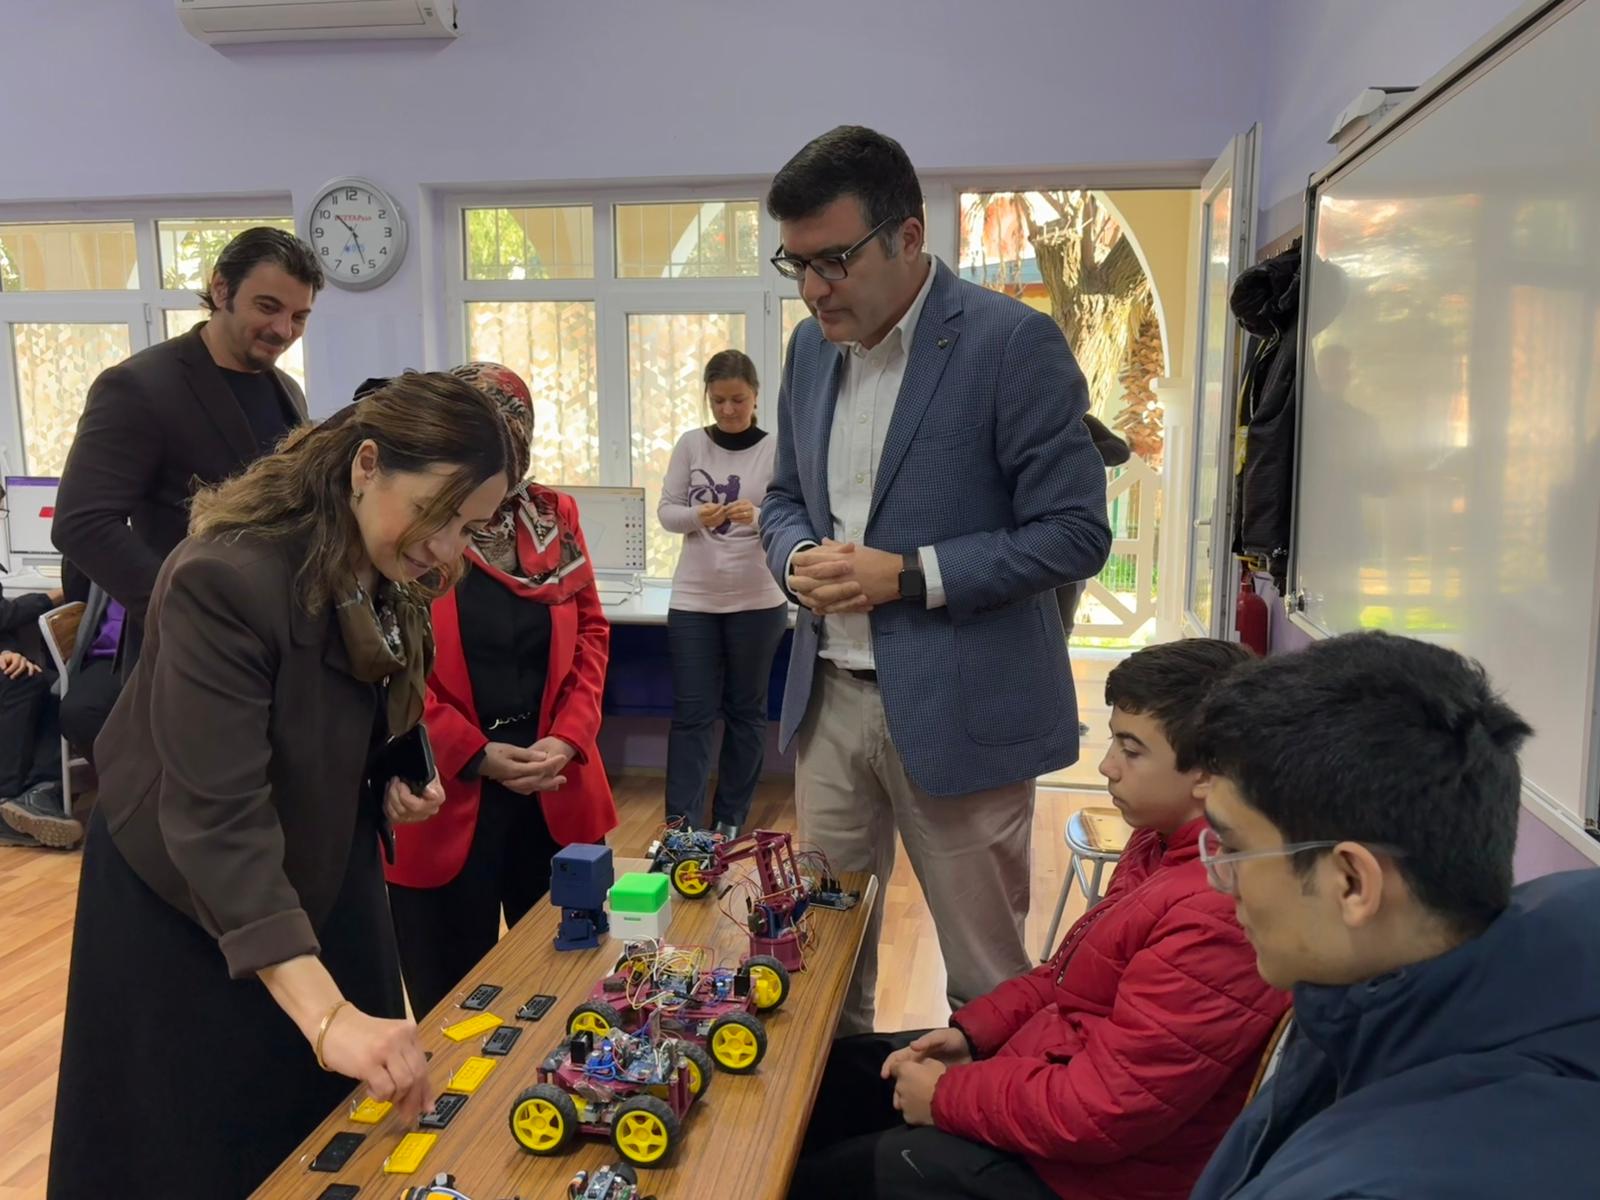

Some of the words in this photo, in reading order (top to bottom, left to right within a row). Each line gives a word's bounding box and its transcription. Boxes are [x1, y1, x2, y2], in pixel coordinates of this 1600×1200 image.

[332, 195, 338, 205] 11
[345, 189, 358, 201] 12
[319, 209, 331, 219] 10
[378, 209, 387, 219] 2
[315, 227, 324, 238] 9
[384, 226, 393, 238] 3
[321, 246, 330, 256] 8
[379, 246, 387, 255] 4
[335, 259, 342, 271] 7
[368, 259, 376, 269] 5
[351, 264, 360, 275] 6
